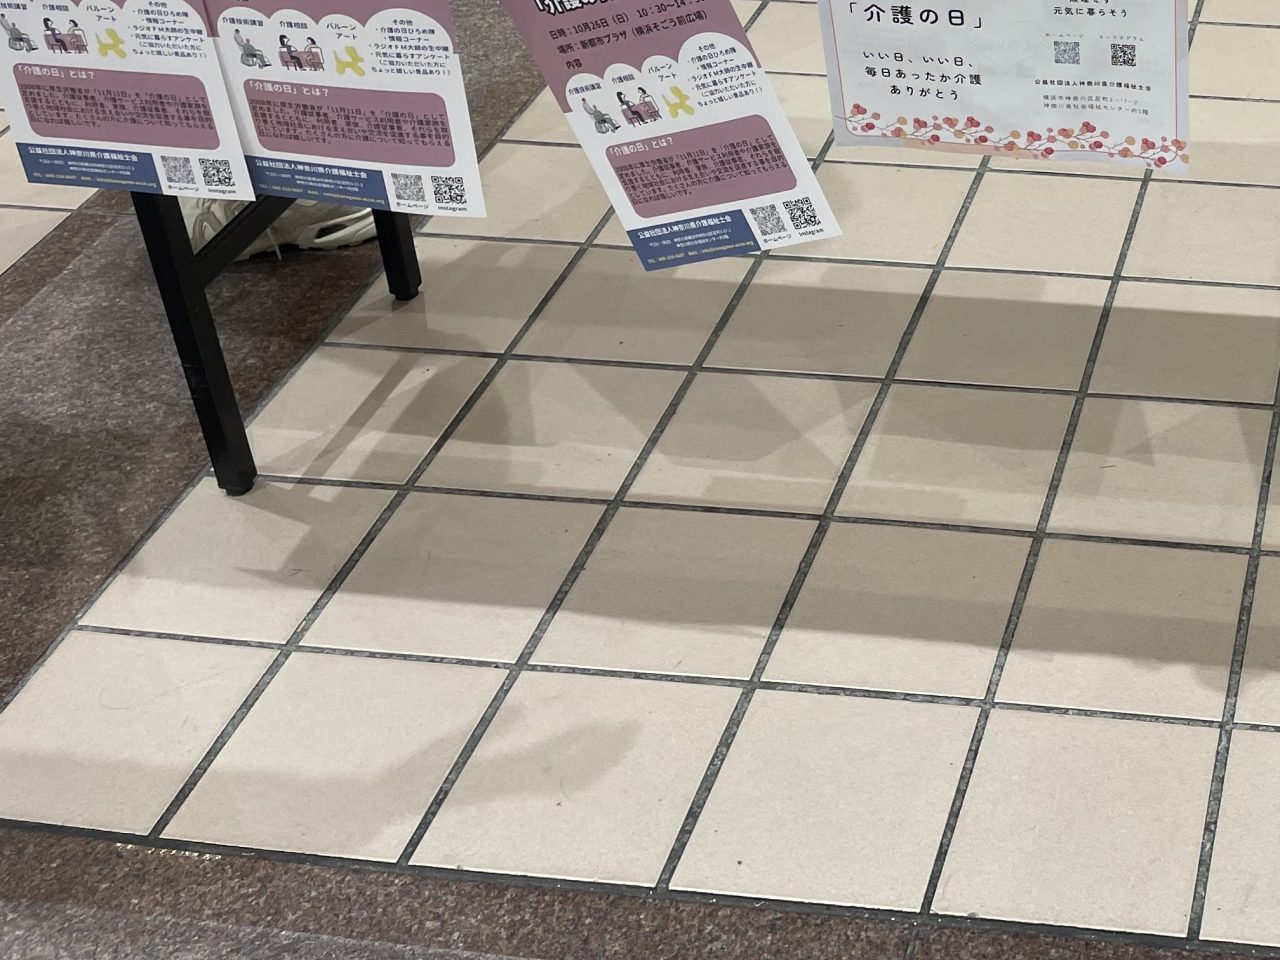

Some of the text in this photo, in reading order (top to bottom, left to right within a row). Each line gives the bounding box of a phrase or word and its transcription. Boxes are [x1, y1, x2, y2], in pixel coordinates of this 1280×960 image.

[848, 2, 984, 30] 「介護の日」
[1053, 6, 1127, 18] 元気に暮らそう
[565, 59, 583, 70] 内容
[863, 50, 976, 68] いい日、いい日、
[864, 65, 983, 87] 毎日あったか介護
[889, 84, 960, 101] ありがとう
